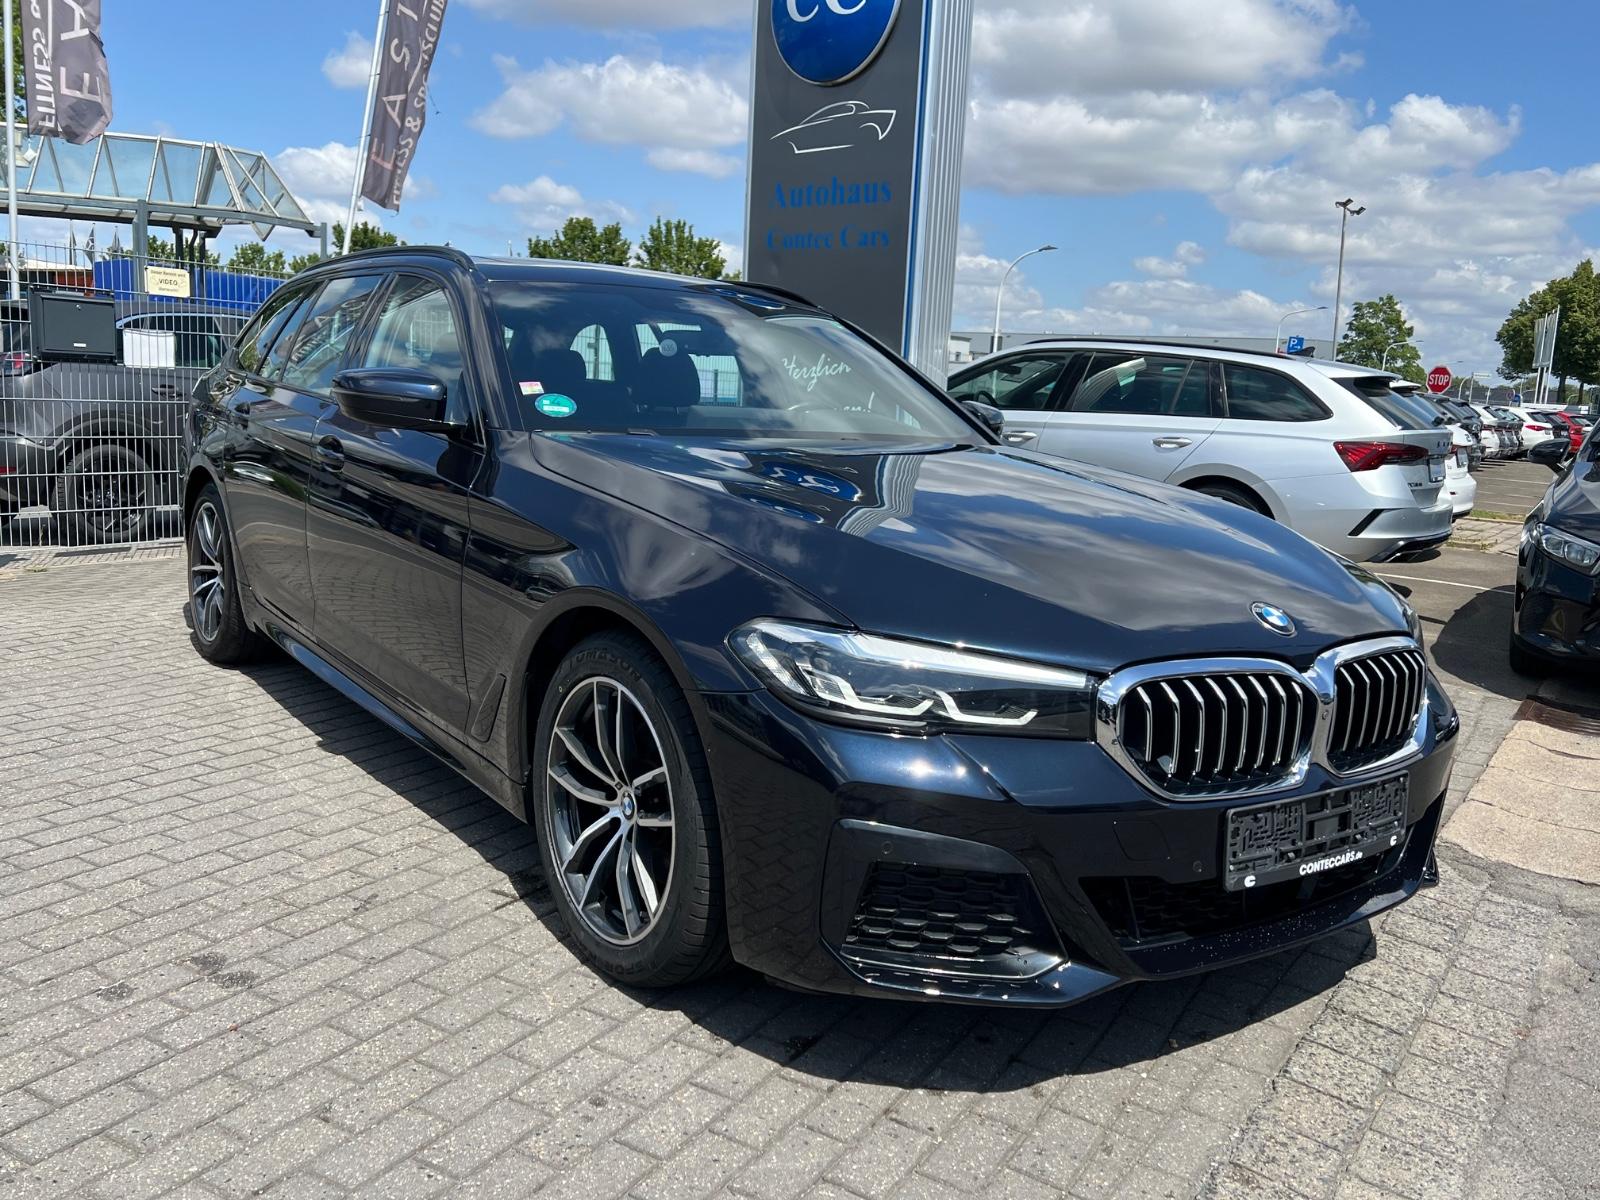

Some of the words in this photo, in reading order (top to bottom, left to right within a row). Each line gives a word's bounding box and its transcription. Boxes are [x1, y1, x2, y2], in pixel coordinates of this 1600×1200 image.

[405, 116, 422, 132] &
[770, 176, 892, 208] Autohaus
[767, 226, 834, 250] Contec
[840, 224, 890, 249] Cars
[1290, 338, 1297, 347] P
[1429, 374, 1449, 385] STOP
[1299, 851, 1363, 875] CONTECCARS.de
